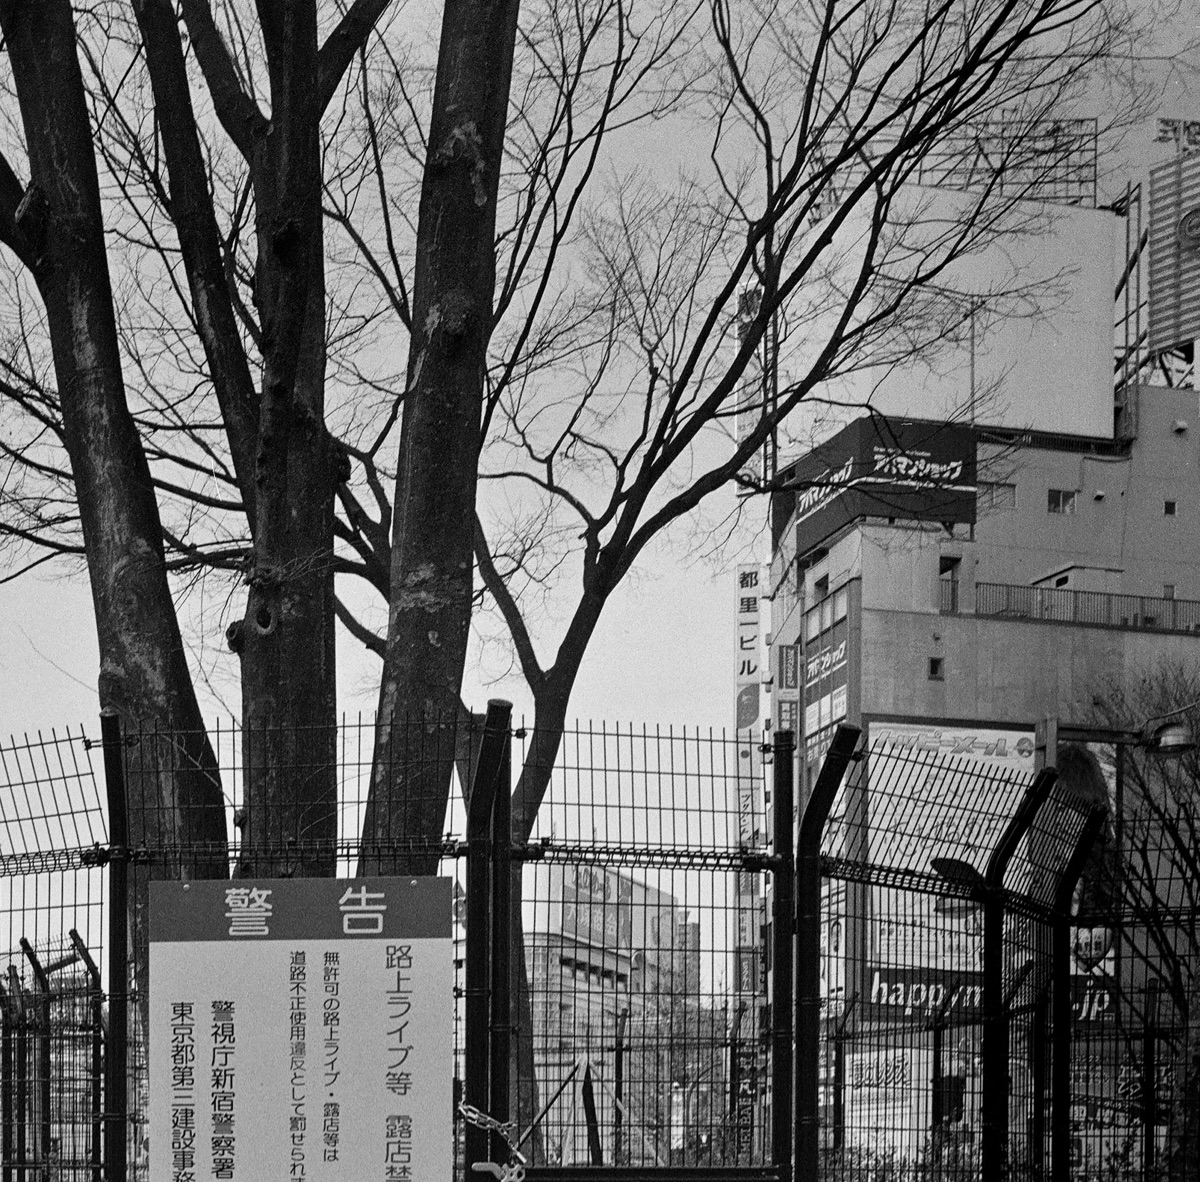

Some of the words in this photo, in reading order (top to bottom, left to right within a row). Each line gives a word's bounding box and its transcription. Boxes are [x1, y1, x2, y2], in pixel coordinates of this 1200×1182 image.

[738, 571, 759, 676] 都里一ビル
[225, 885, 387, 936] 警告
[211, 999, 236, 1180] 警視庁新宿警察署
[323, 950, 341, 1162] 無許可の路上ライブ・露店等は
[385, 944, 414, 1096] 路上ライブ等
